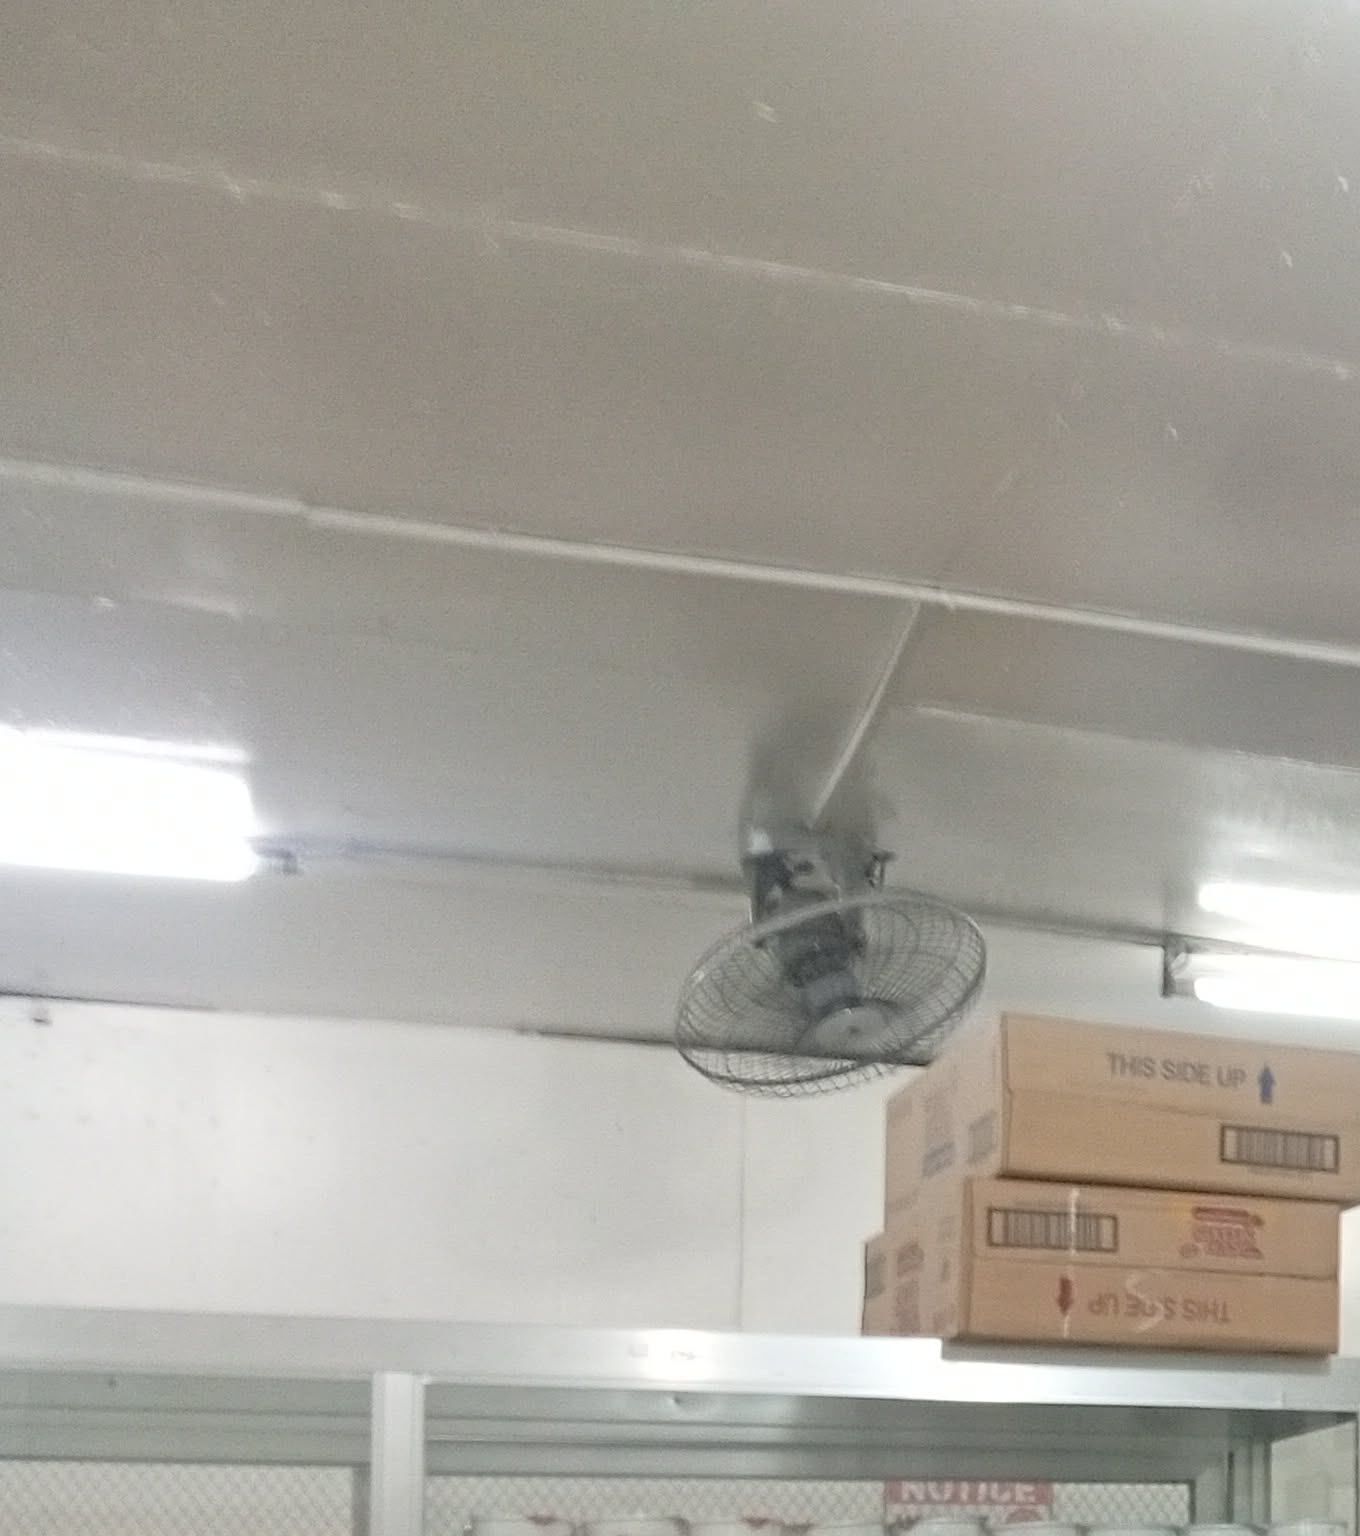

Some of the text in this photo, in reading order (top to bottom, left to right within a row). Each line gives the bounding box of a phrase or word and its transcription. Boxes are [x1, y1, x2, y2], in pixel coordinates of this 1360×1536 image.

[1106, 1052, 1247, 1088] THIS SIDE UP
[1087, 1292, 1230, 1323] THIS SDE UP
[901, 1481, 1036, 1503] NOTICE
